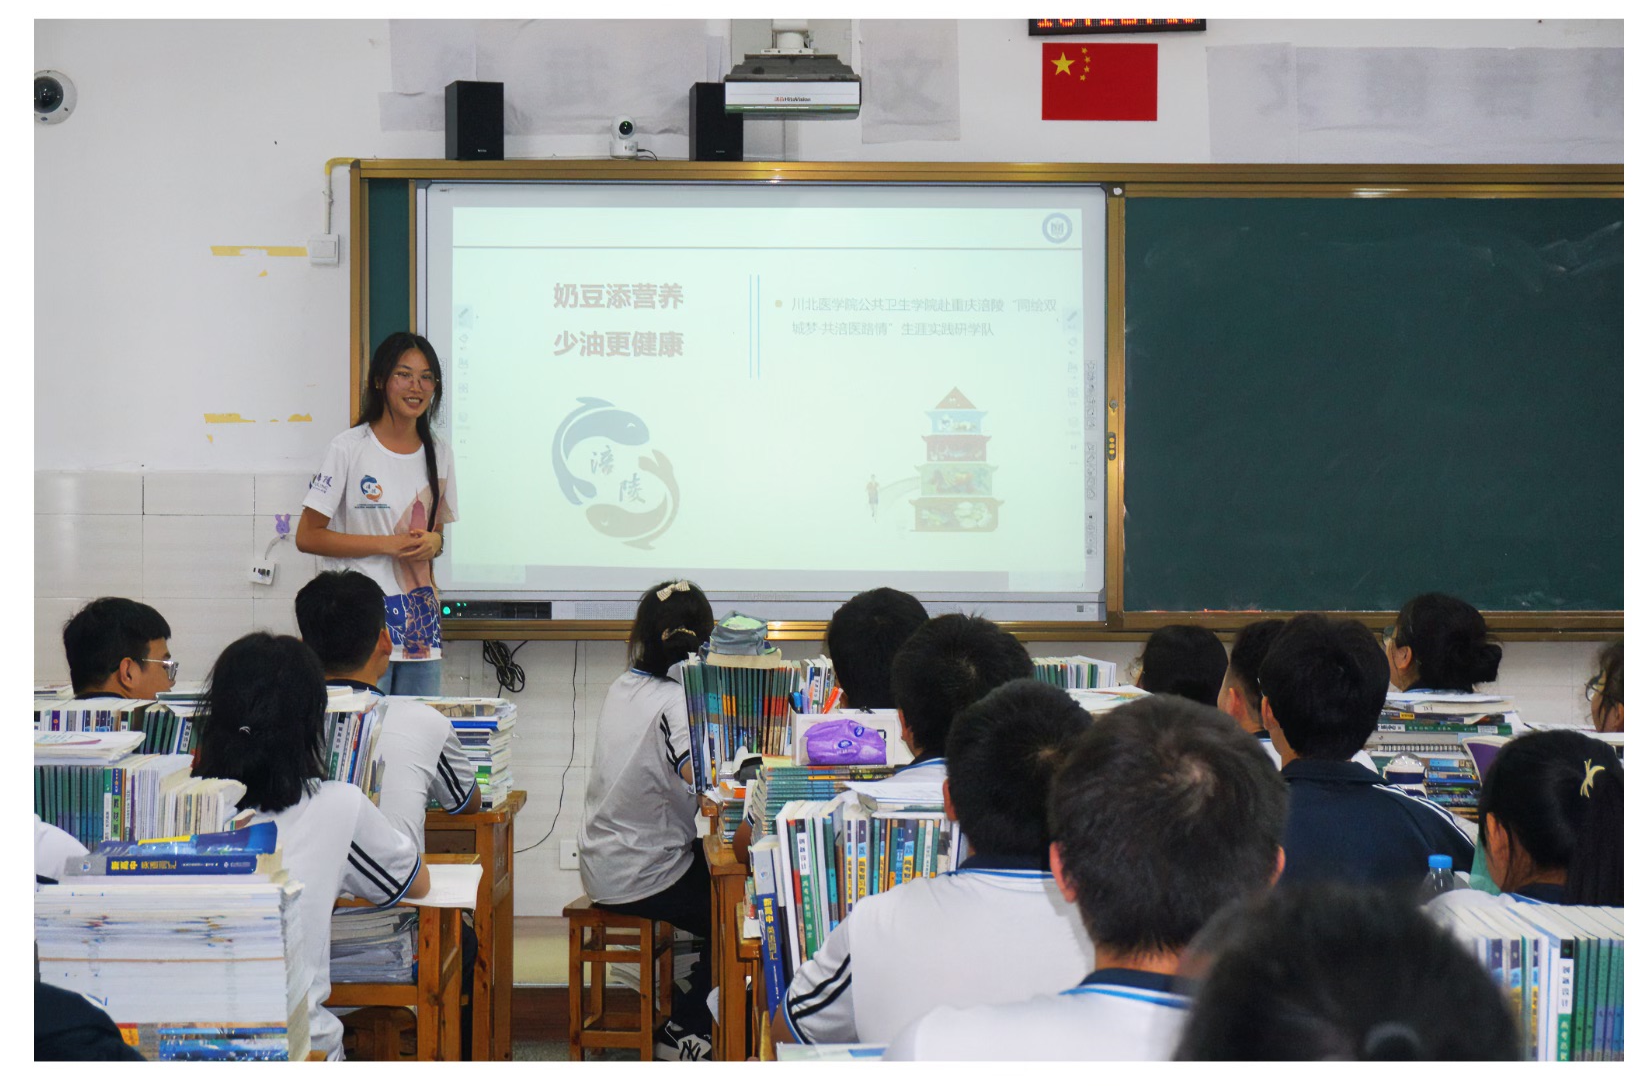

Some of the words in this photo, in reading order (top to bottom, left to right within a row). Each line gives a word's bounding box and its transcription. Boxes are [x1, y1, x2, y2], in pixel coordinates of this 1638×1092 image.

[553, 283, 684, 311] 奶豆添营养
[553, 330, 684, 358] 少油更健康
